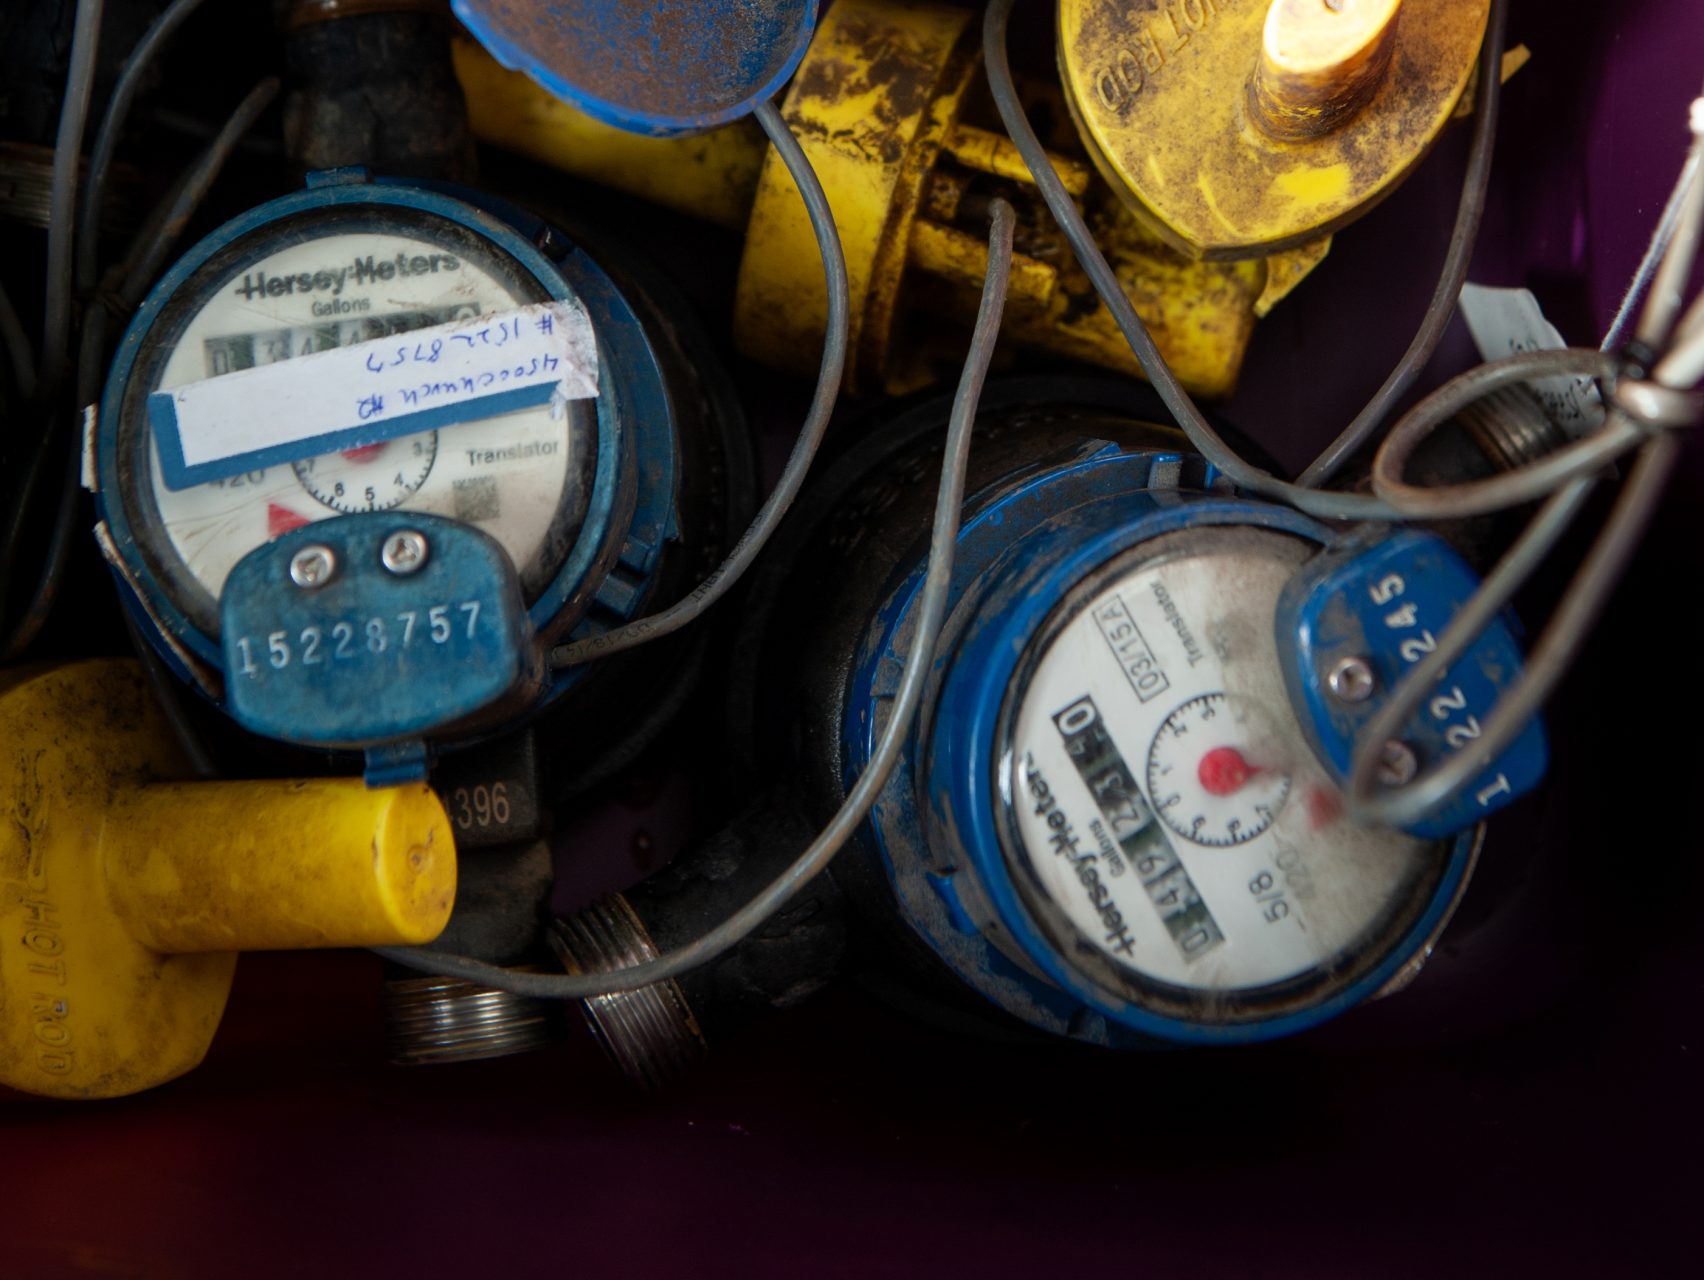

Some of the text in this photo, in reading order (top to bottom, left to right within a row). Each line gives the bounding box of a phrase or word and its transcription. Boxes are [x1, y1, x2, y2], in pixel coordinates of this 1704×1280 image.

[1096, 28, 1165, 112] ROD
[311, 297, 371, 317] Gallons
[465, 441, 560, 467] Translator
[237, 600, 481, 675] 15228757
[1150, 580, 1203, 668] Translator
[1369, 574, 1512, 806] 122245
[1089, 819, 1127, 878] Gallons
[1249, 871, 1289, 923] 5/8
[22, 899, 74, 1076] HOT ROD
